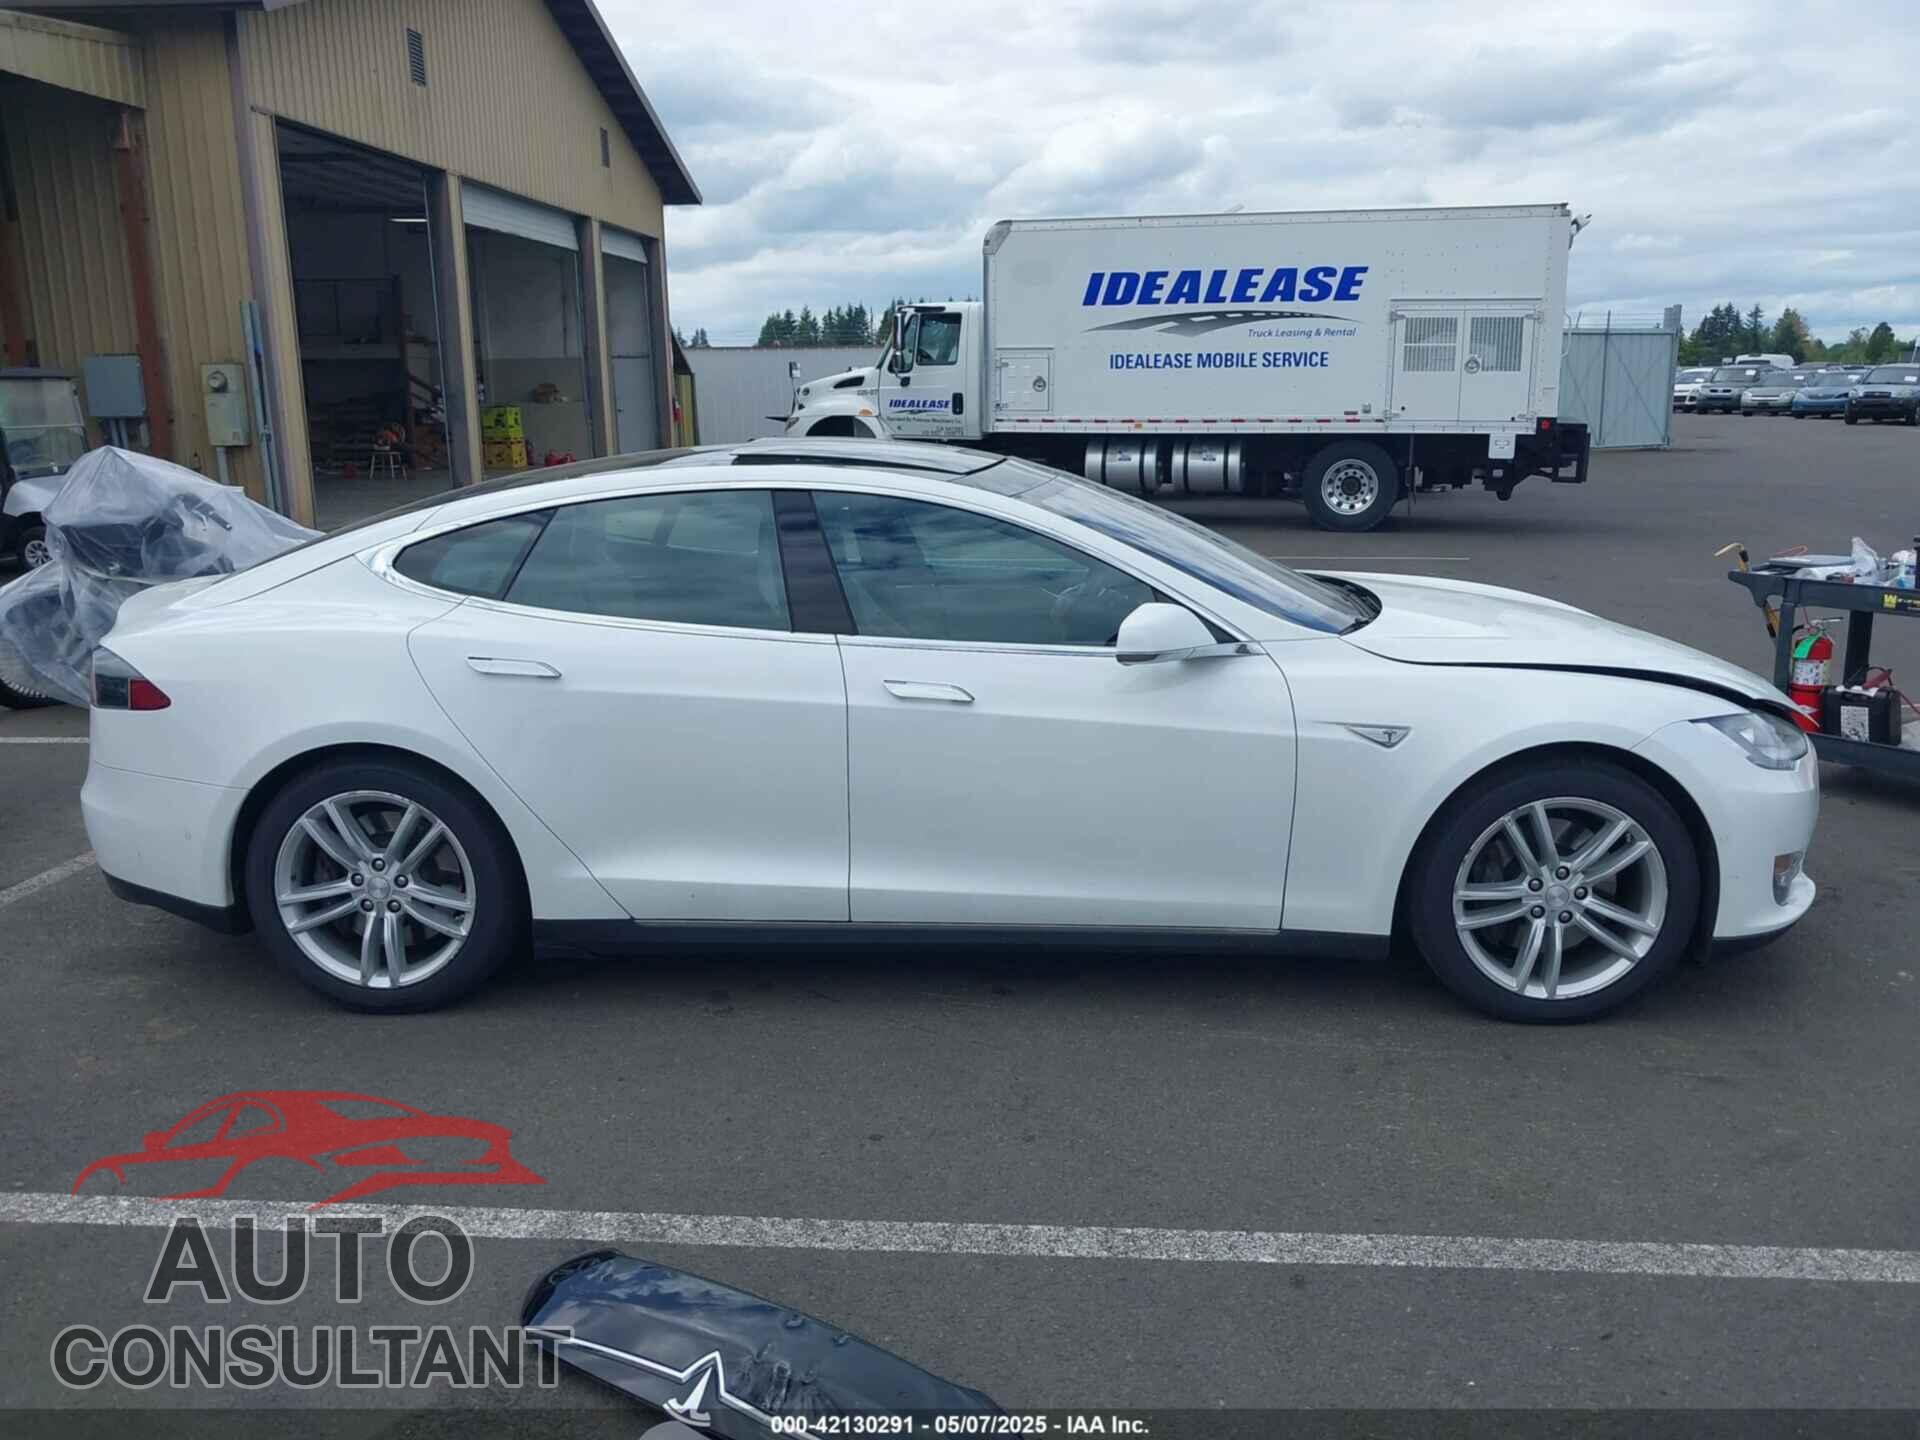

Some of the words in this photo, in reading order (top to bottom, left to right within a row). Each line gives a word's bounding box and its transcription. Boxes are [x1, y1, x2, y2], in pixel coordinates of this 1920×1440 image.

[1082, 266, 1369, 306] IDEALEASE
[1248, 328, 1273, 338] Truck
[1275, 328, 1313, 339] Leasing
[1314, 328, 1322, 337] &
[1323, 327, 1357, 337] Rental
[1110, 353, 1193, 370] IDEALEASE
[1196, 352, 1258, 369] MOBILE
[1262, 351, 1330, 368] SERVICE
[889, 399, 951, 409] IDEALEASE
